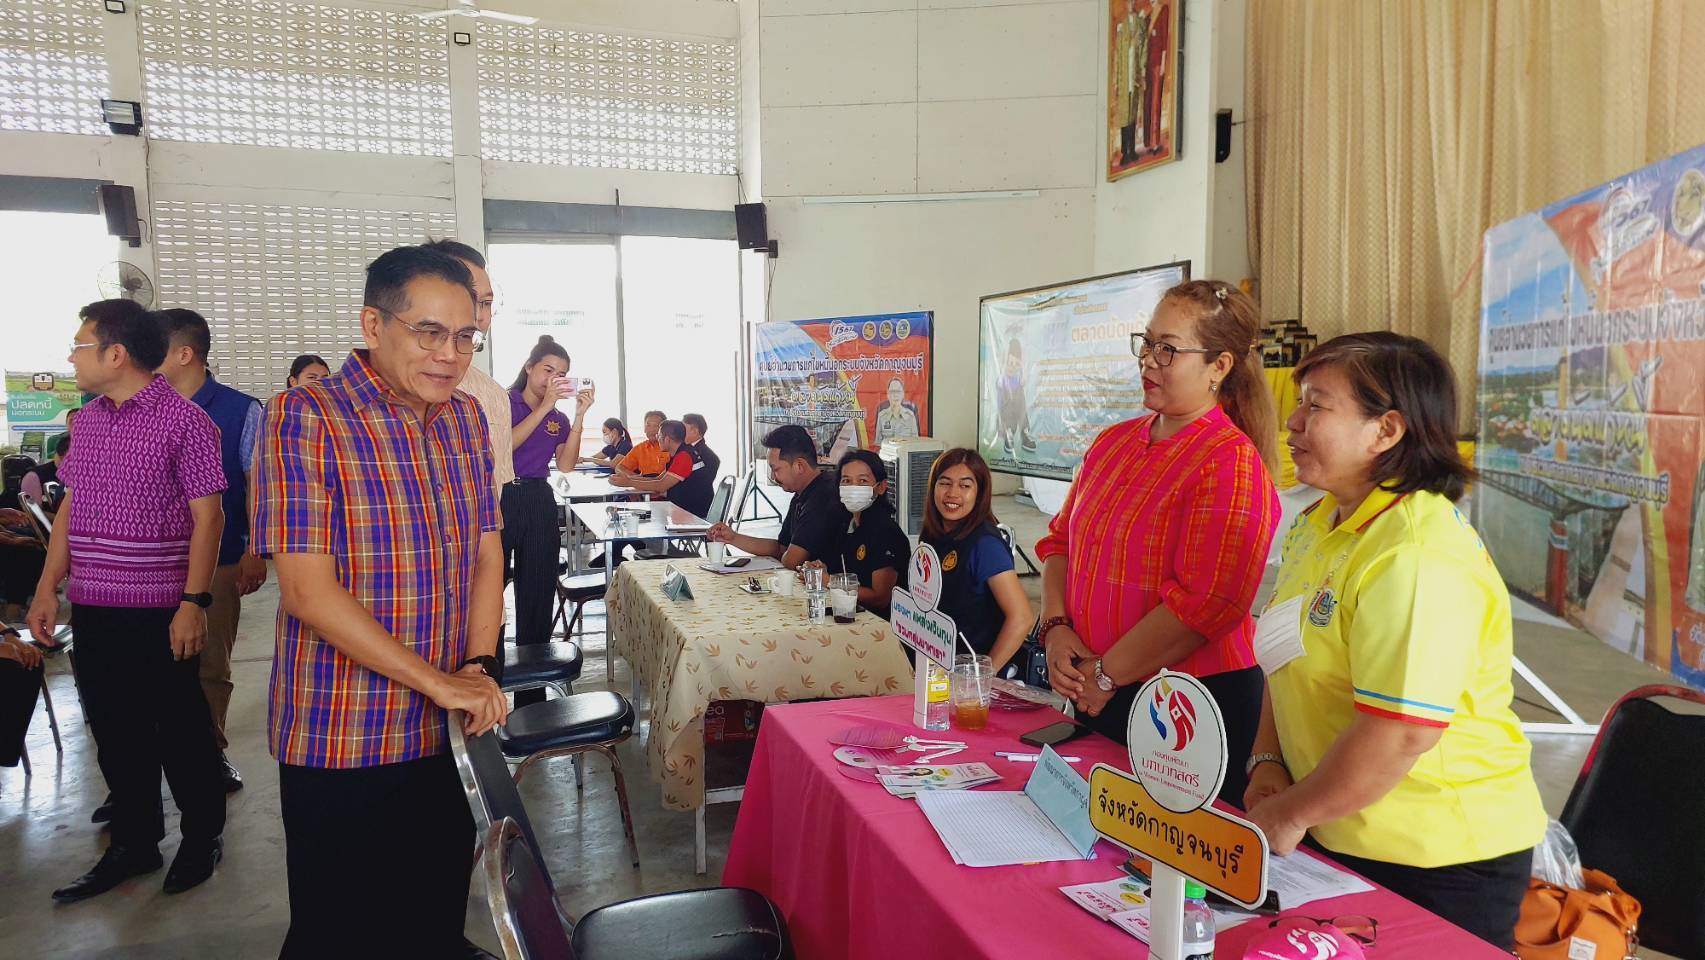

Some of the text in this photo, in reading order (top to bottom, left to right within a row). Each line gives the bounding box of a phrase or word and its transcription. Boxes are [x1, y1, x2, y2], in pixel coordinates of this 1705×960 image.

[1142, 757, 1200, 788] บทบาทสตรี
[1098, 788, 1244, 879] จังหวัดกาญจนบุรี
